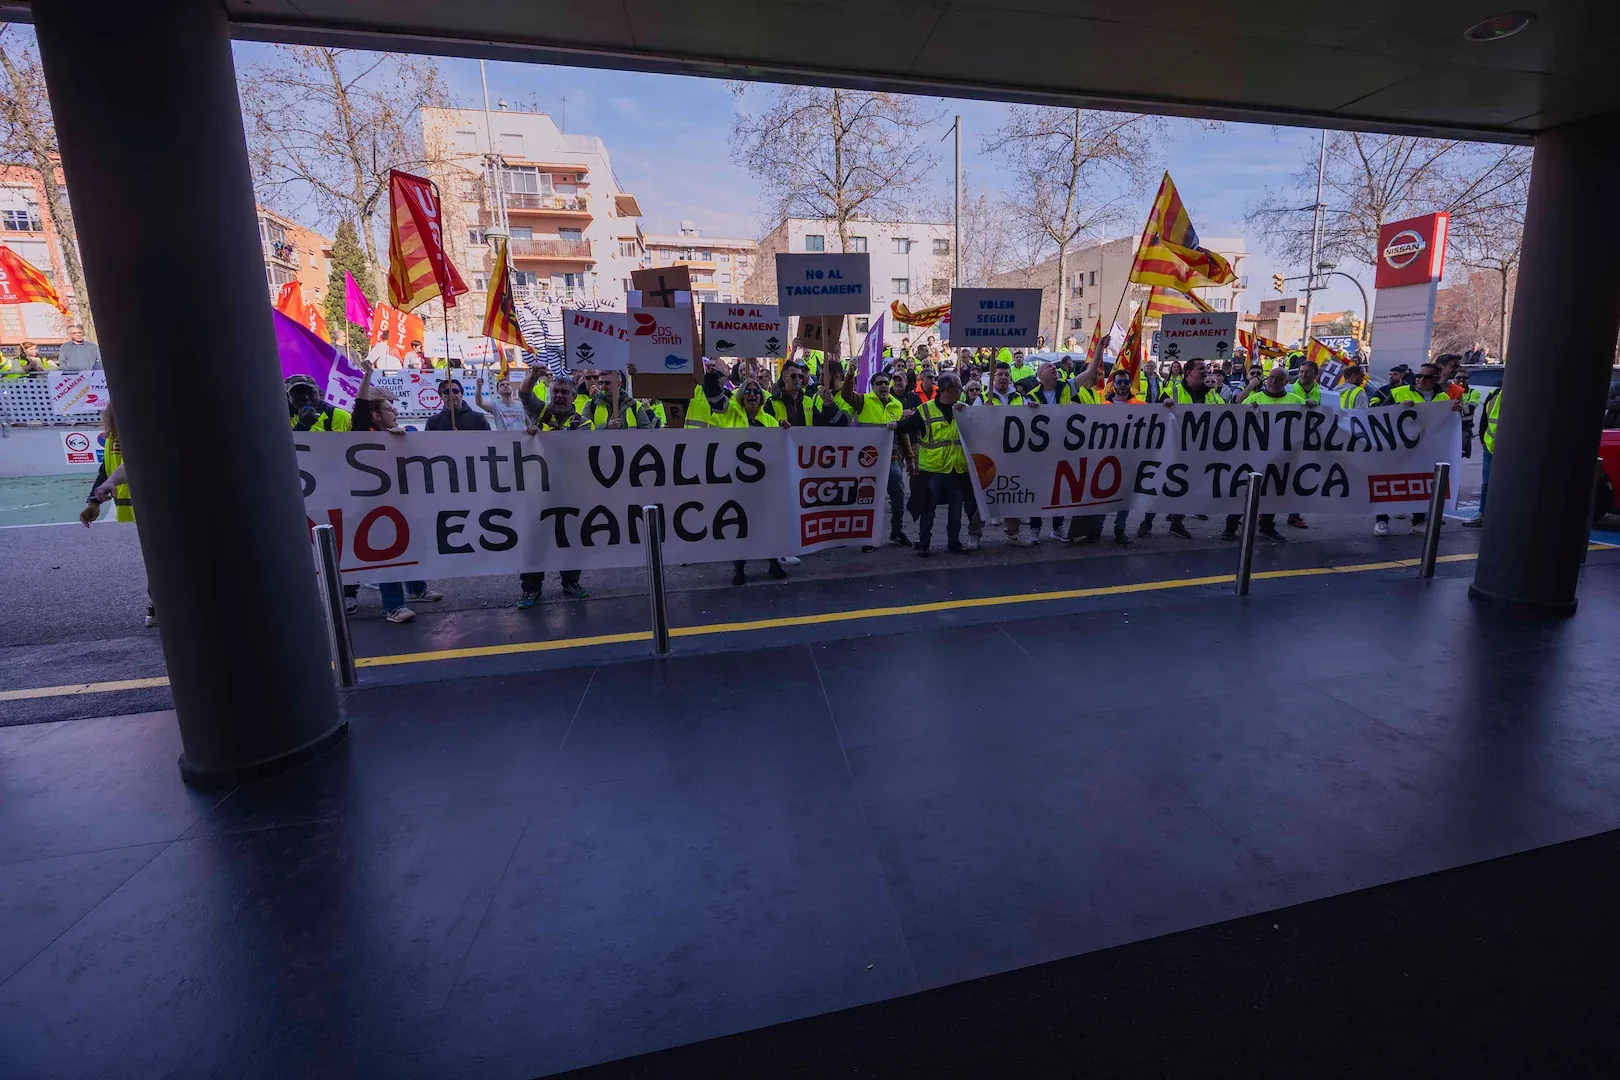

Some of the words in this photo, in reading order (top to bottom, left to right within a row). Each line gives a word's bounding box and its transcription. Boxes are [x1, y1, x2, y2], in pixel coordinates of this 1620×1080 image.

[1386, 243, 1420, 255] NISSAN
[806, 270, 824, 279] NO
[828, 269, 843, 278] AL
[785, 284, 863, 296] TANCAMENT
[980, 300, 1014, 309] VOLEM
[728, 308, 745, 316] NO
[749, 309, 763, 317] AL
[977, 315, 1016, 323] SEGUIR
[1200, 317, 1212, 325] AL
[573, 314, 629, 341] PIRAT
[657, 326, 672, 336] DS
[709, 320, 780, 331] TANCAMENT
[964, 328, 1027, 336] TREBALLANT
[1165, 329, 1228, 338] TANCAMENT
[651, 335, 682, 345] Smith
[53, 374, 86, 402] TANCAMENT
[1003, 414, 1050, 453] DS
[1063, 413, 1166, 451] Smith
[1181, 409, 1421, 452] MONTBLANC
[797, 445, 854, 468] UGT
[345, 441, 550, 497] Smith
[588, 441, 766, 488] VALLS
[997, 475, 1020, 490] DS
[1051, 455, 1122, 505] NO
[1134, 461, 1189, 498] ES
[1205, 462, 1349, 498] TANCA
[803, 481, 855, 503] CGT
[986, 488, 1034, 504] Smith
[436, 508, 518, 554] ES
[540, 500, 748, 548] TANCA
[805, 516, 868, 538] CCOO
